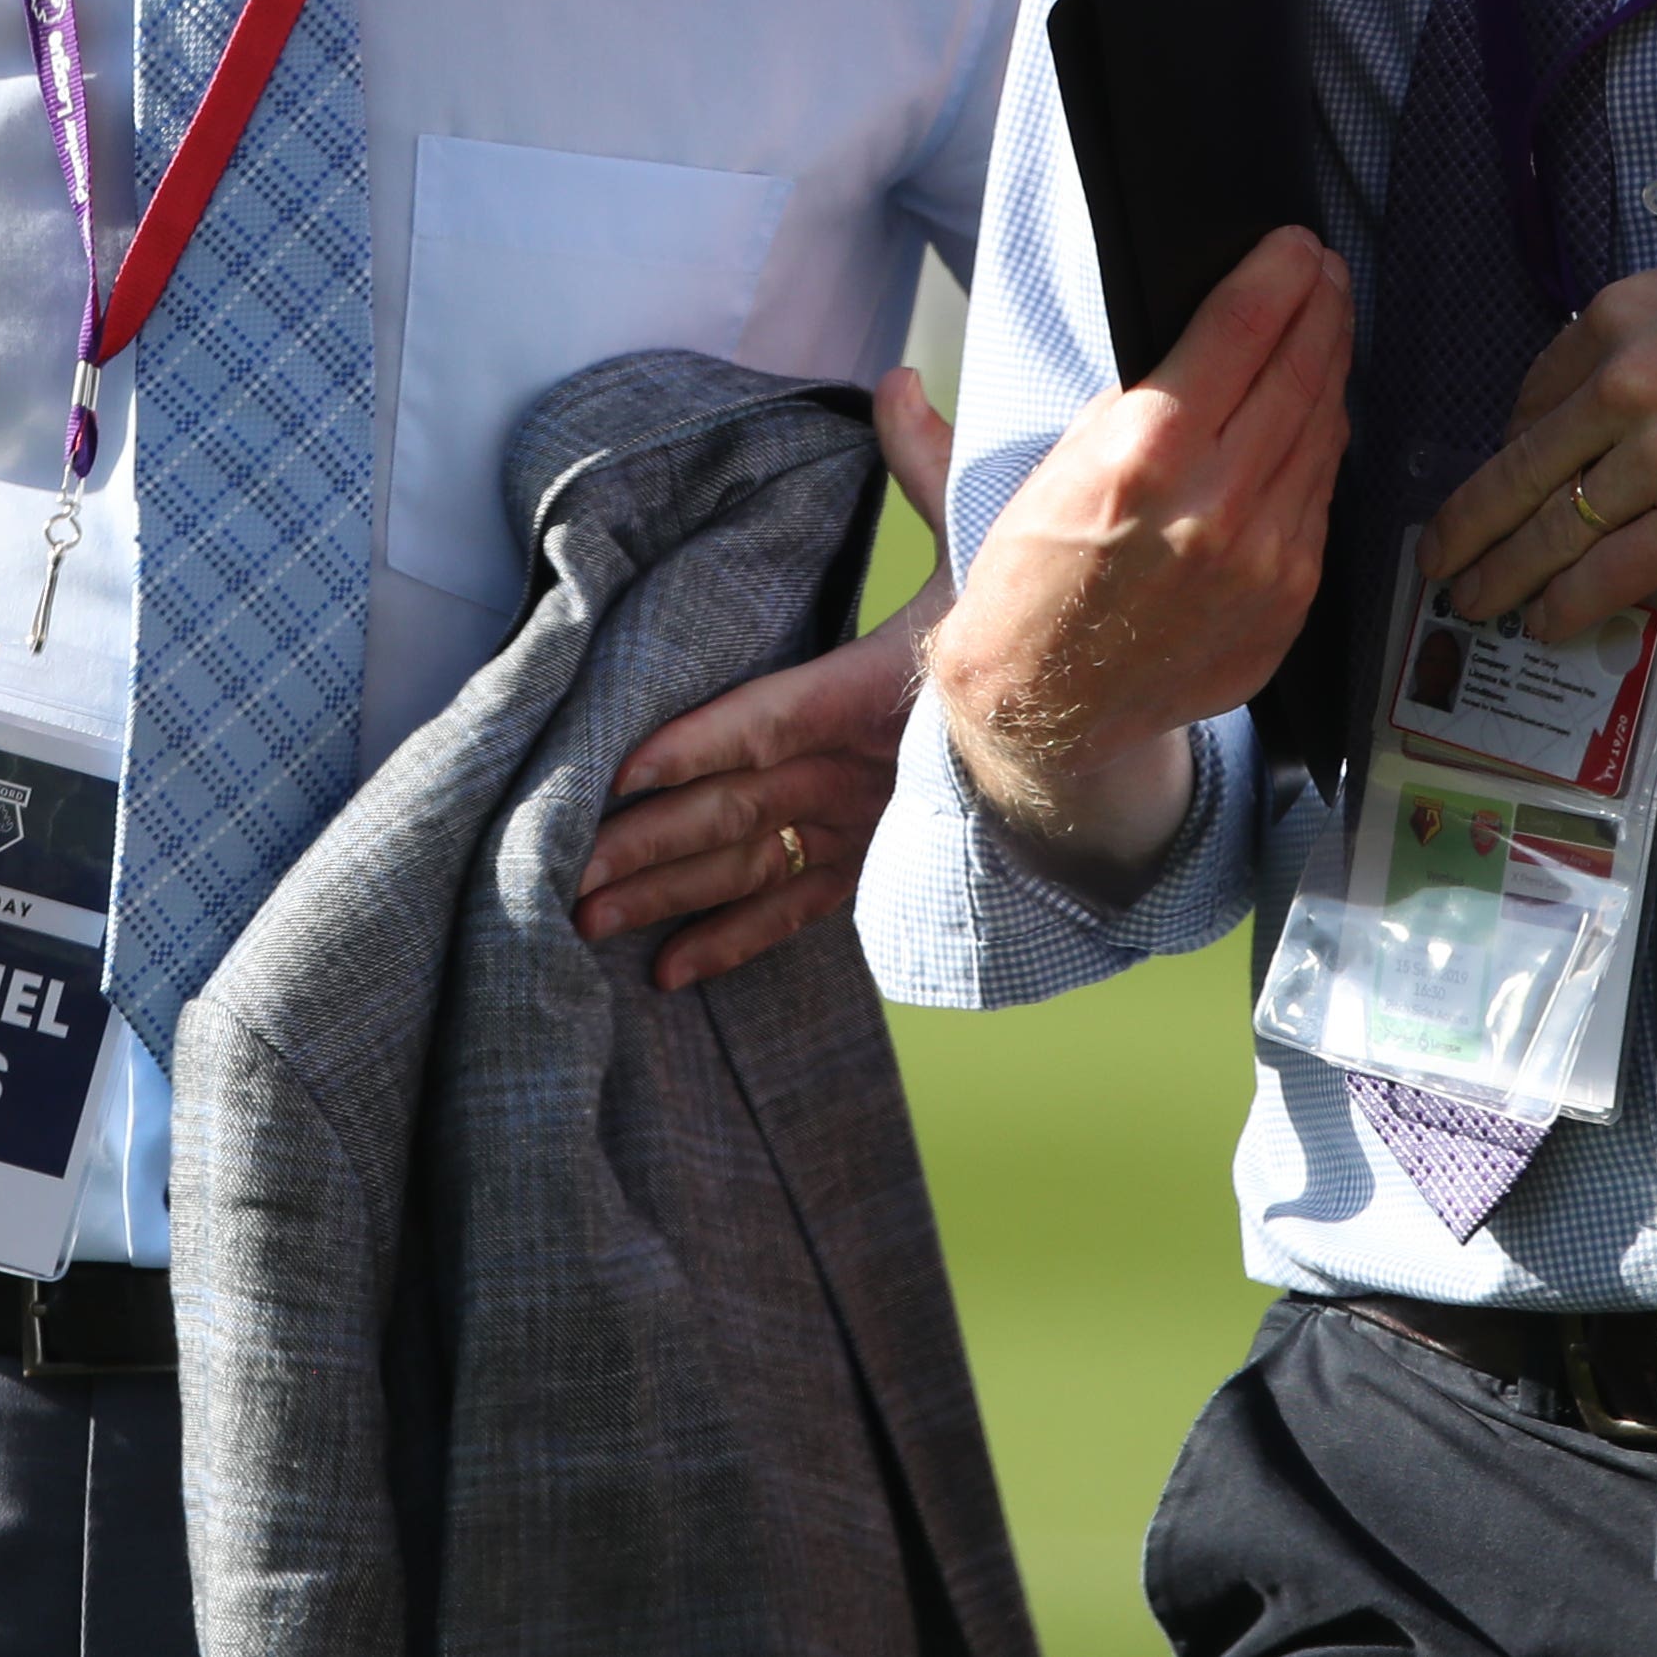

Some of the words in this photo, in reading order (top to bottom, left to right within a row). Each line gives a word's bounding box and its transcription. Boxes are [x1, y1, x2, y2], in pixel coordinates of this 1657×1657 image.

[48, 30, 73, 119] League
[64, 119, 89, 205] Premier
[1603, 757, 1618, 781] TV
[1611, 713, 1629, 758] 19/20
